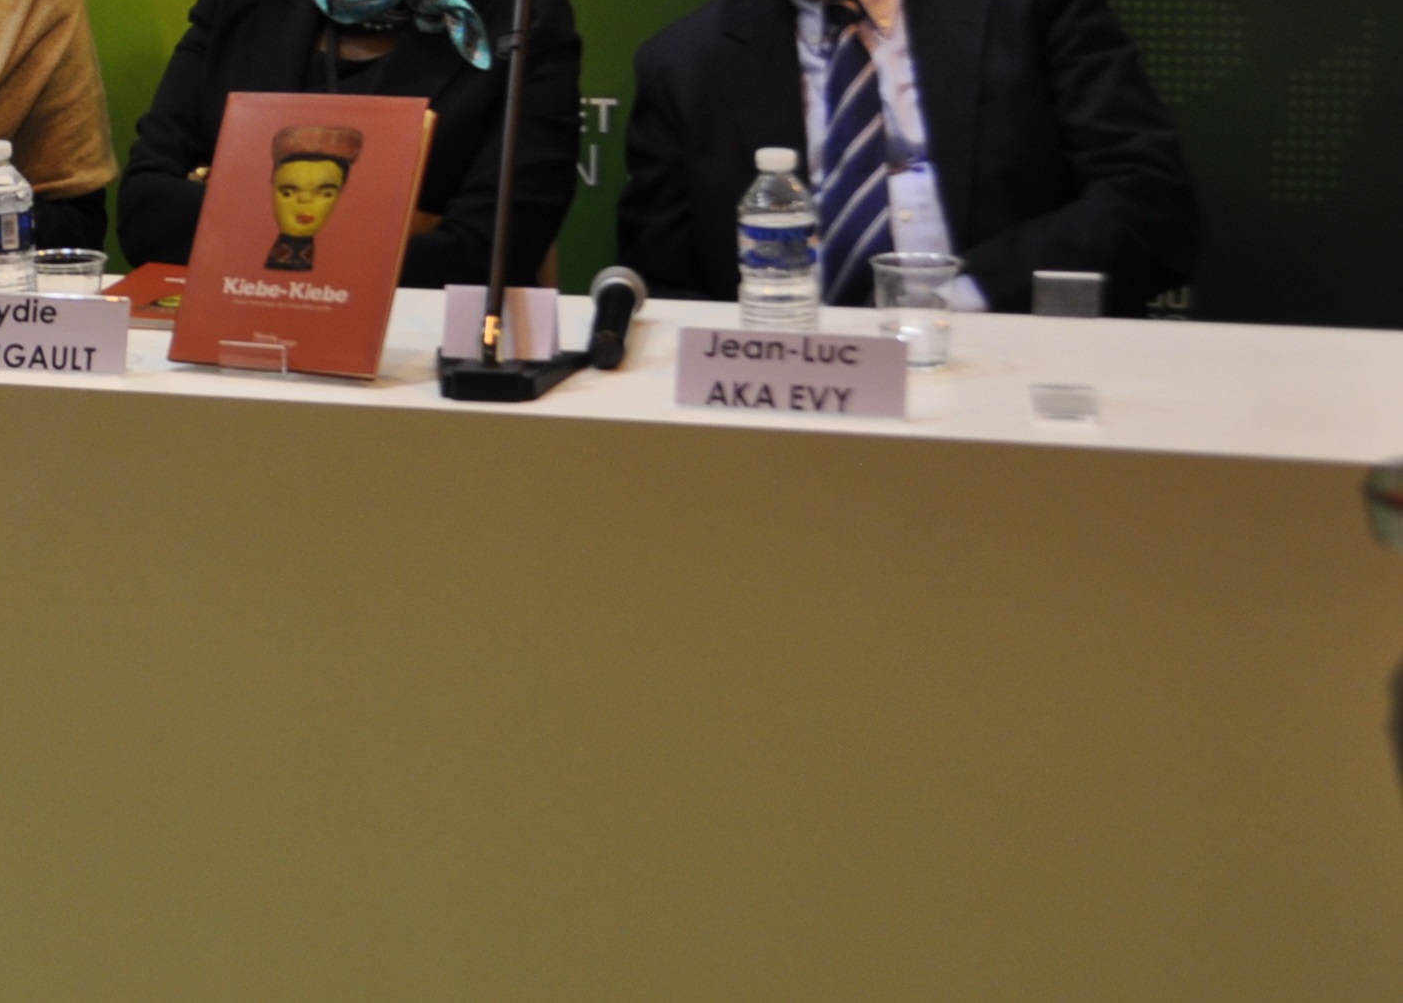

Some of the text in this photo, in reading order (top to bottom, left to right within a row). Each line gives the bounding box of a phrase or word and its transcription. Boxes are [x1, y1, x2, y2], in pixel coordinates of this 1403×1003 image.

[704, 331, 859, 365] Jean-Luc
[706, 380, 853, 412] AKA EVY
